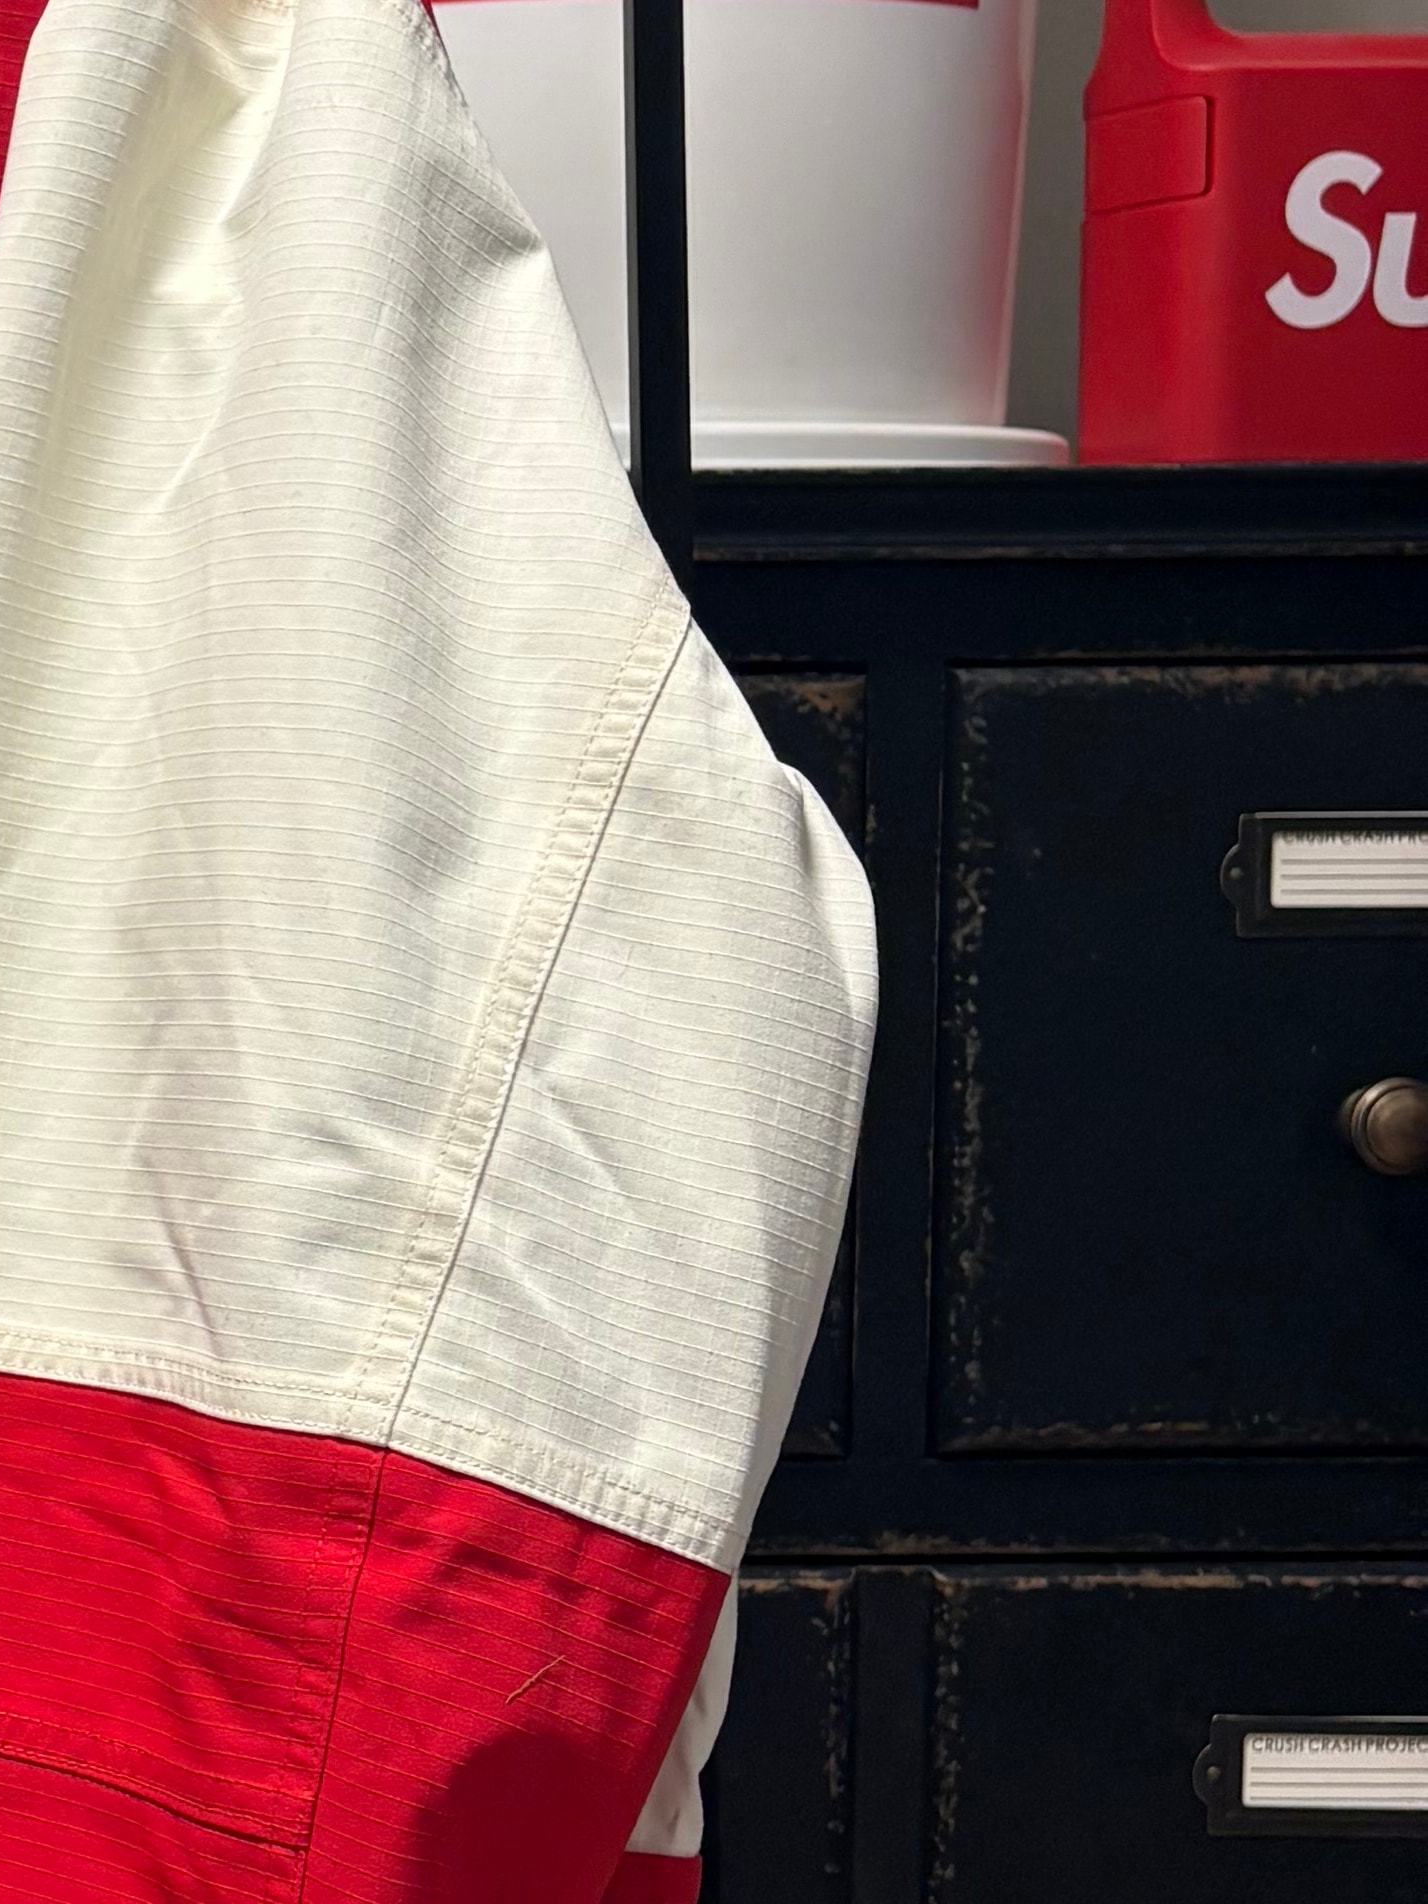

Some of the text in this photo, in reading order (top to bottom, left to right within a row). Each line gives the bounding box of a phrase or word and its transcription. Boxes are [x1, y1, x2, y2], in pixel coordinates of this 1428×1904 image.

[1251, 1736, 1428, 1754] CRUSH CRASH PROJEC
